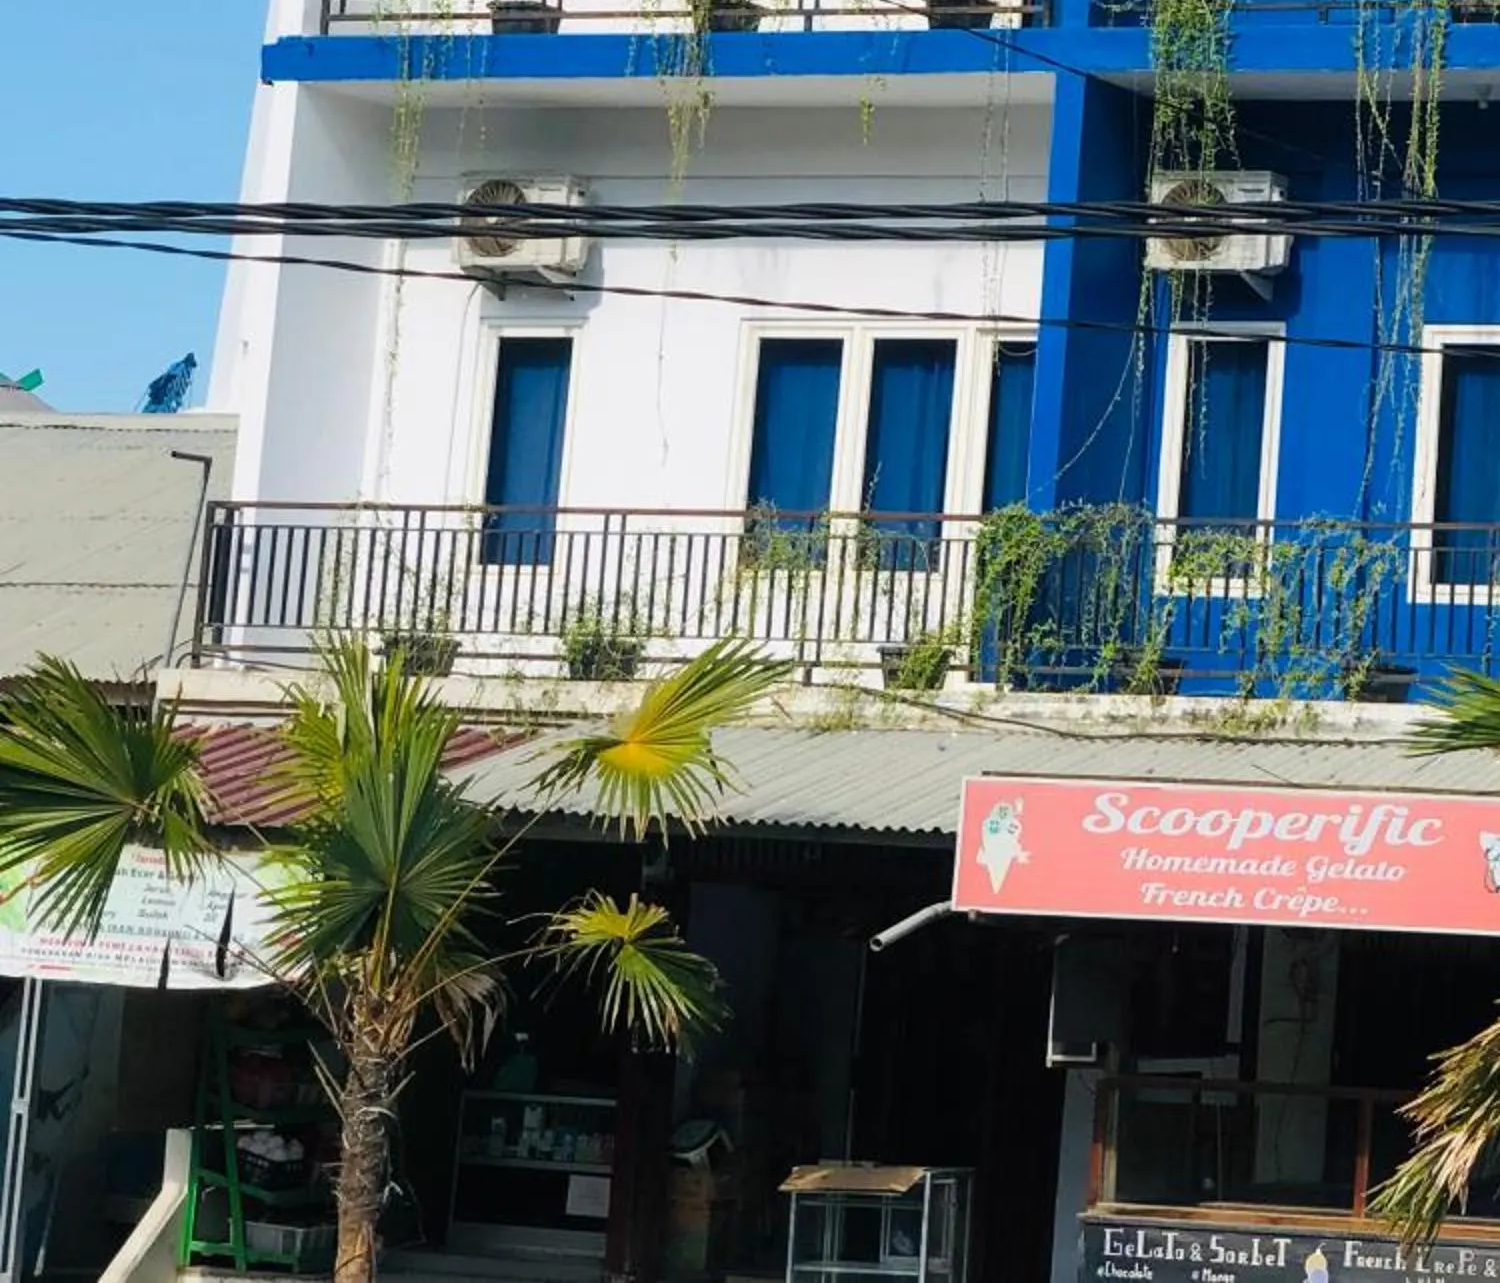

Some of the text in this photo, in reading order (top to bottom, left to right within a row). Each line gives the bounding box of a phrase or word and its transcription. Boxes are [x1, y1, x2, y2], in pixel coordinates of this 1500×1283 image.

[1082, 791, 1445, 855] Scooperific
[1121, 847, 1407, 883] Homemade Gelato
[1140, 882, 1244, 908] French
[1189, 1242, 1203, 1262] &
[1483, 1257, 1497, 1277] &
